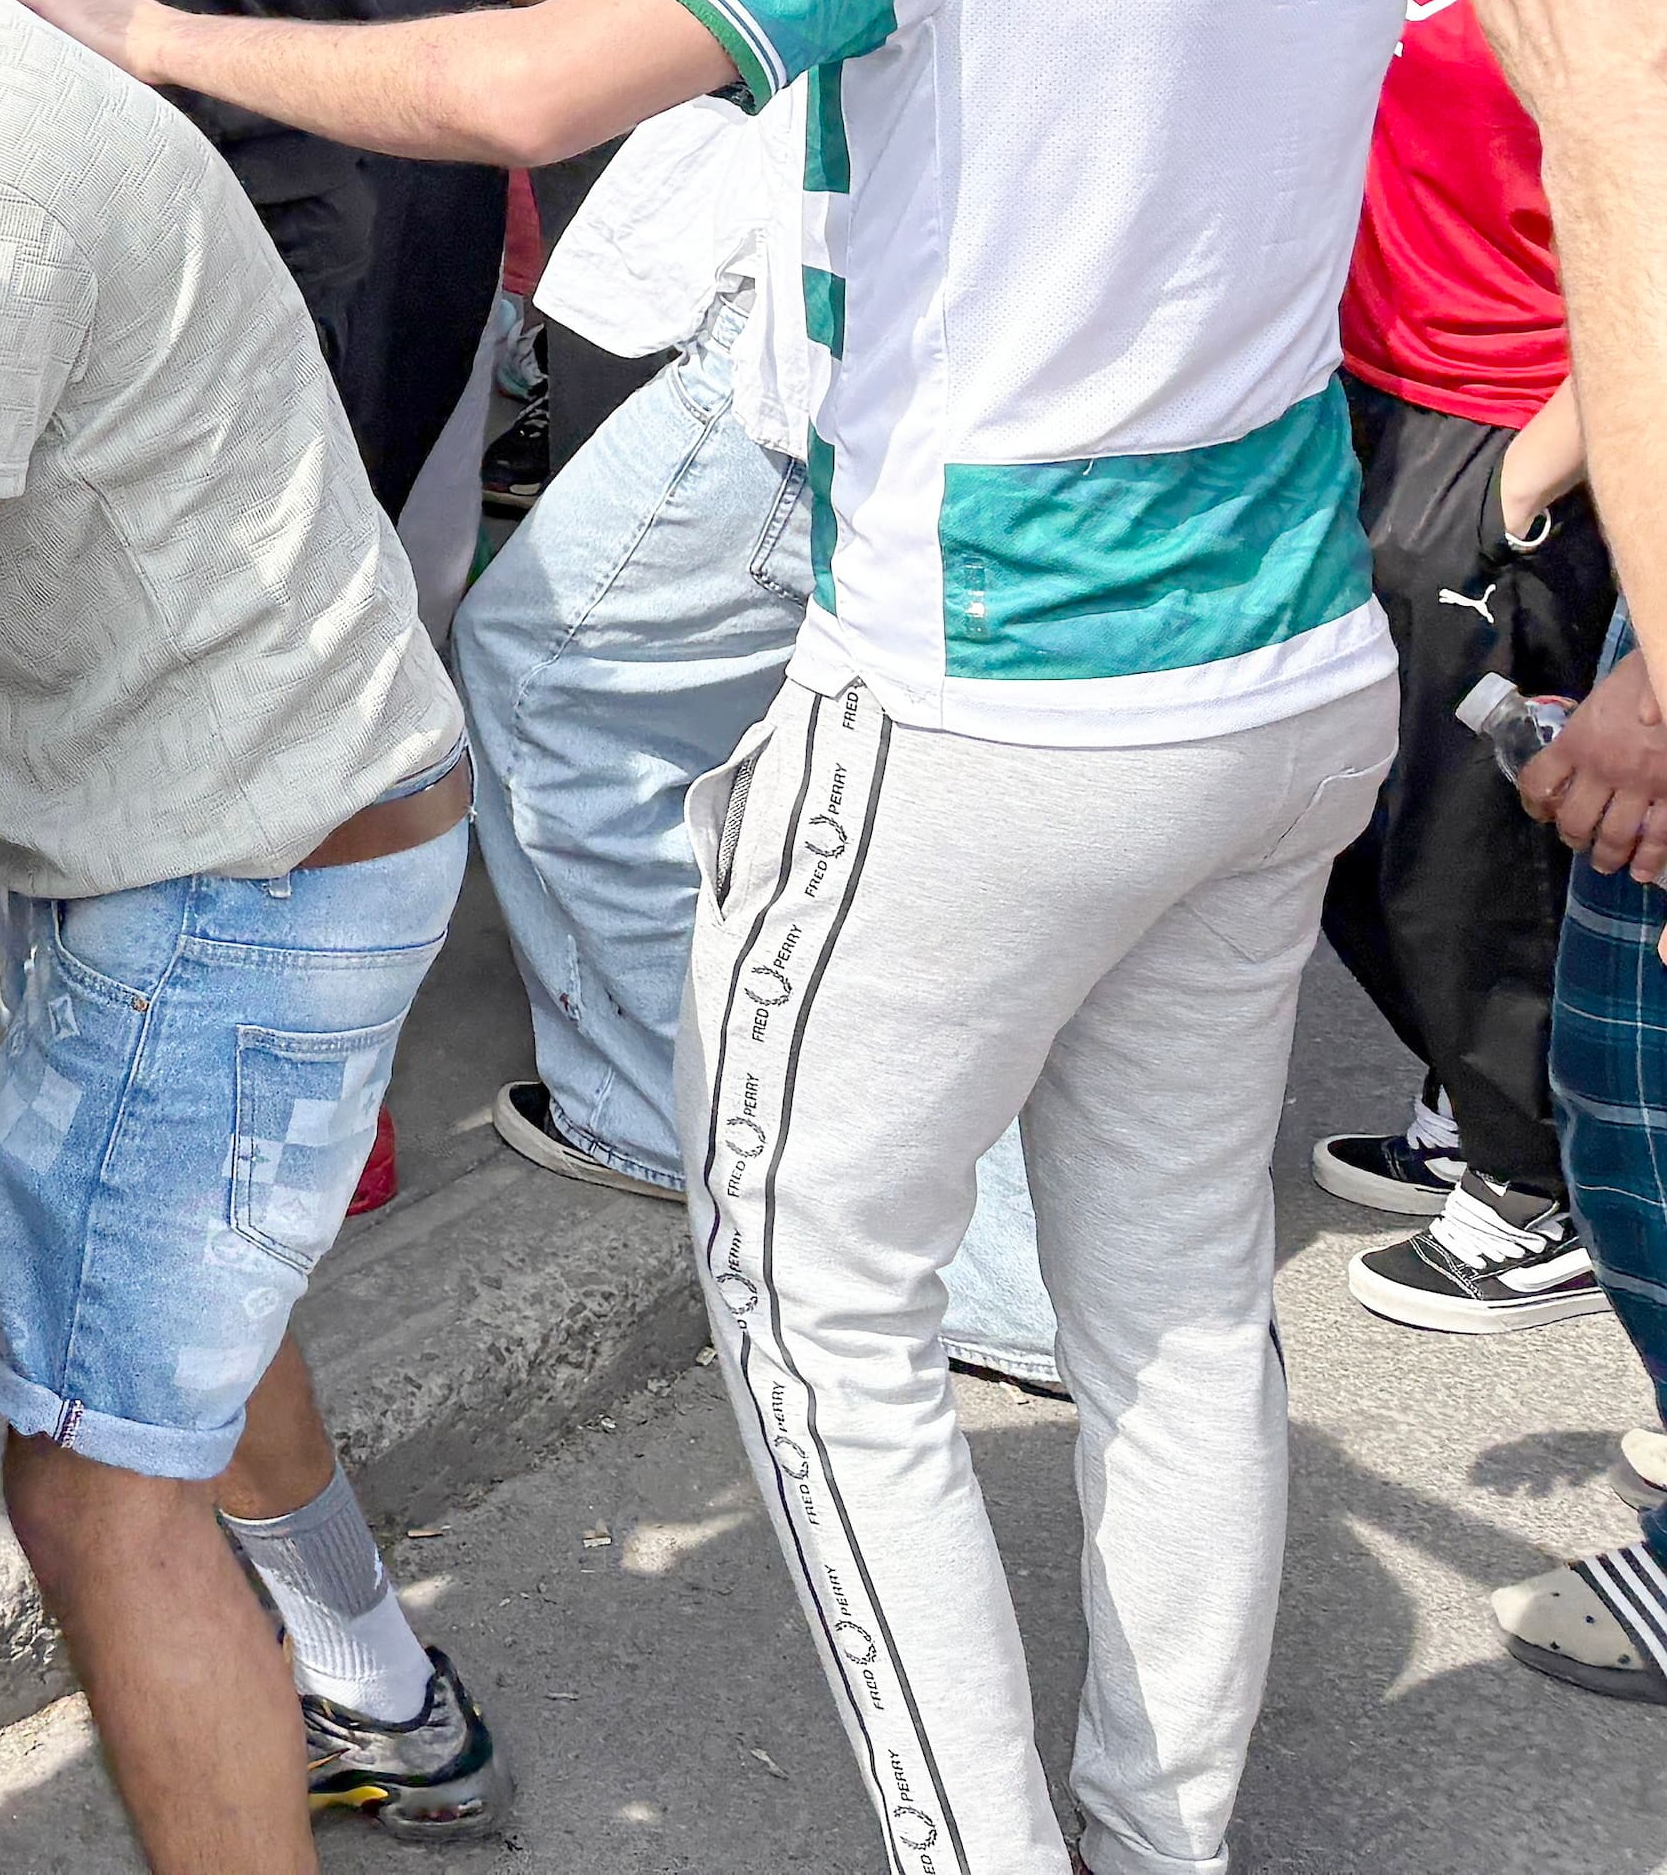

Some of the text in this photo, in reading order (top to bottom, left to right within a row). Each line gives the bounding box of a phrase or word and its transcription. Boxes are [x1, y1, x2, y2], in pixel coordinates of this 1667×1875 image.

[841, 691, 860, 730] FRED
[804, 762, 848, 898] FRED PERRY
[751, 923, 804, 1043] FRED PERRY
[727, 1072, 760, 1199] FRED PERRY
[771, 1380, 820, 1526] FRED PERRY
[824, 1564, 885, 1711] FRED PERRY
[887, 1748, 914, 1803] PERRY
